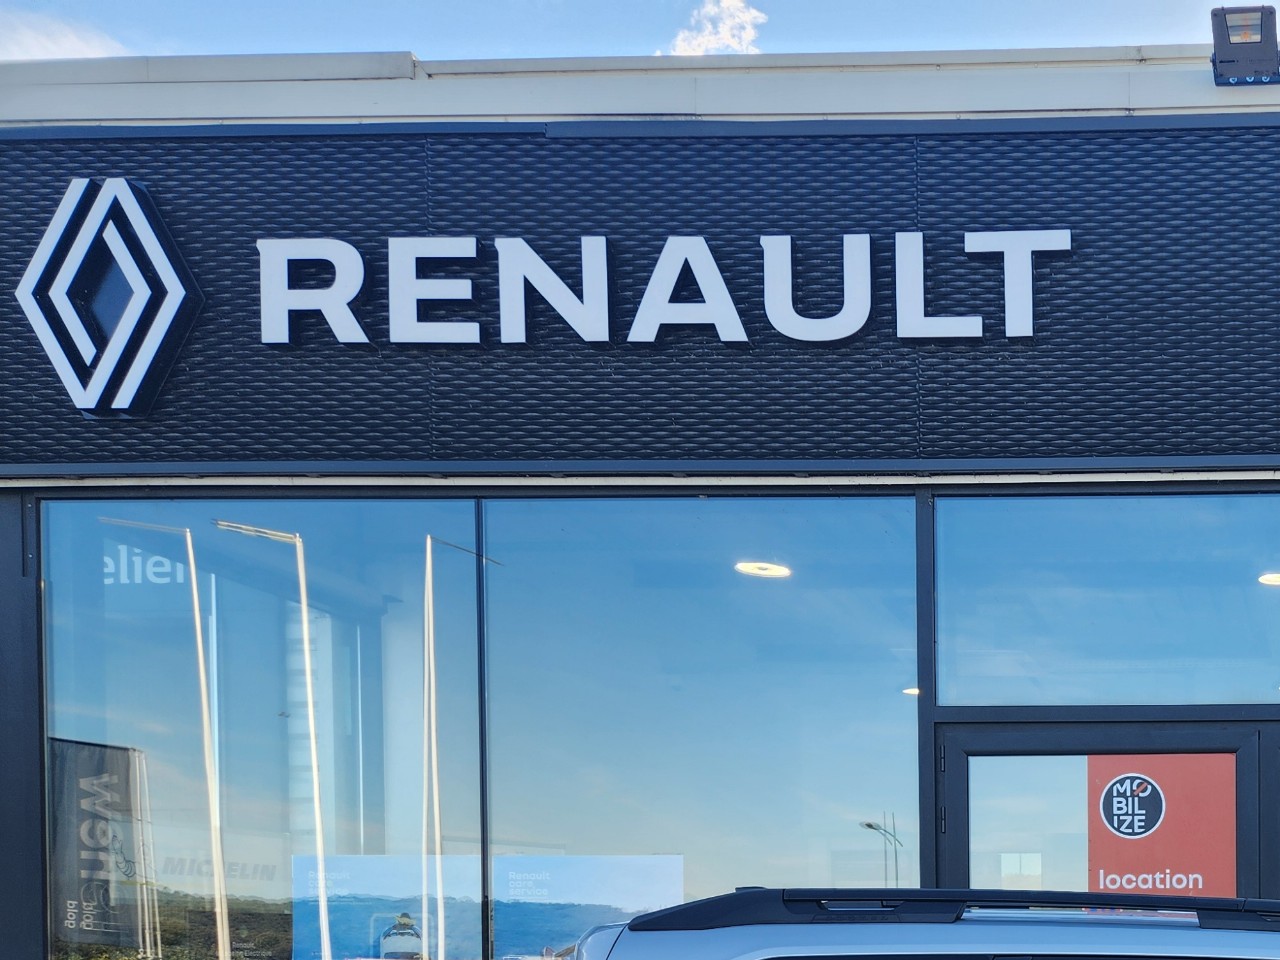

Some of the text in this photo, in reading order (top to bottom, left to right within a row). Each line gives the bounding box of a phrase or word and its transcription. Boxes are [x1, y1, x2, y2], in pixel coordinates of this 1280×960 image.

[256, 229, 1072, 345] RENAULT
[161, 857, 277, 881] MICELIN
[508, 871, 552, 880] Renault
[1099, 869, 1203, 889] location
